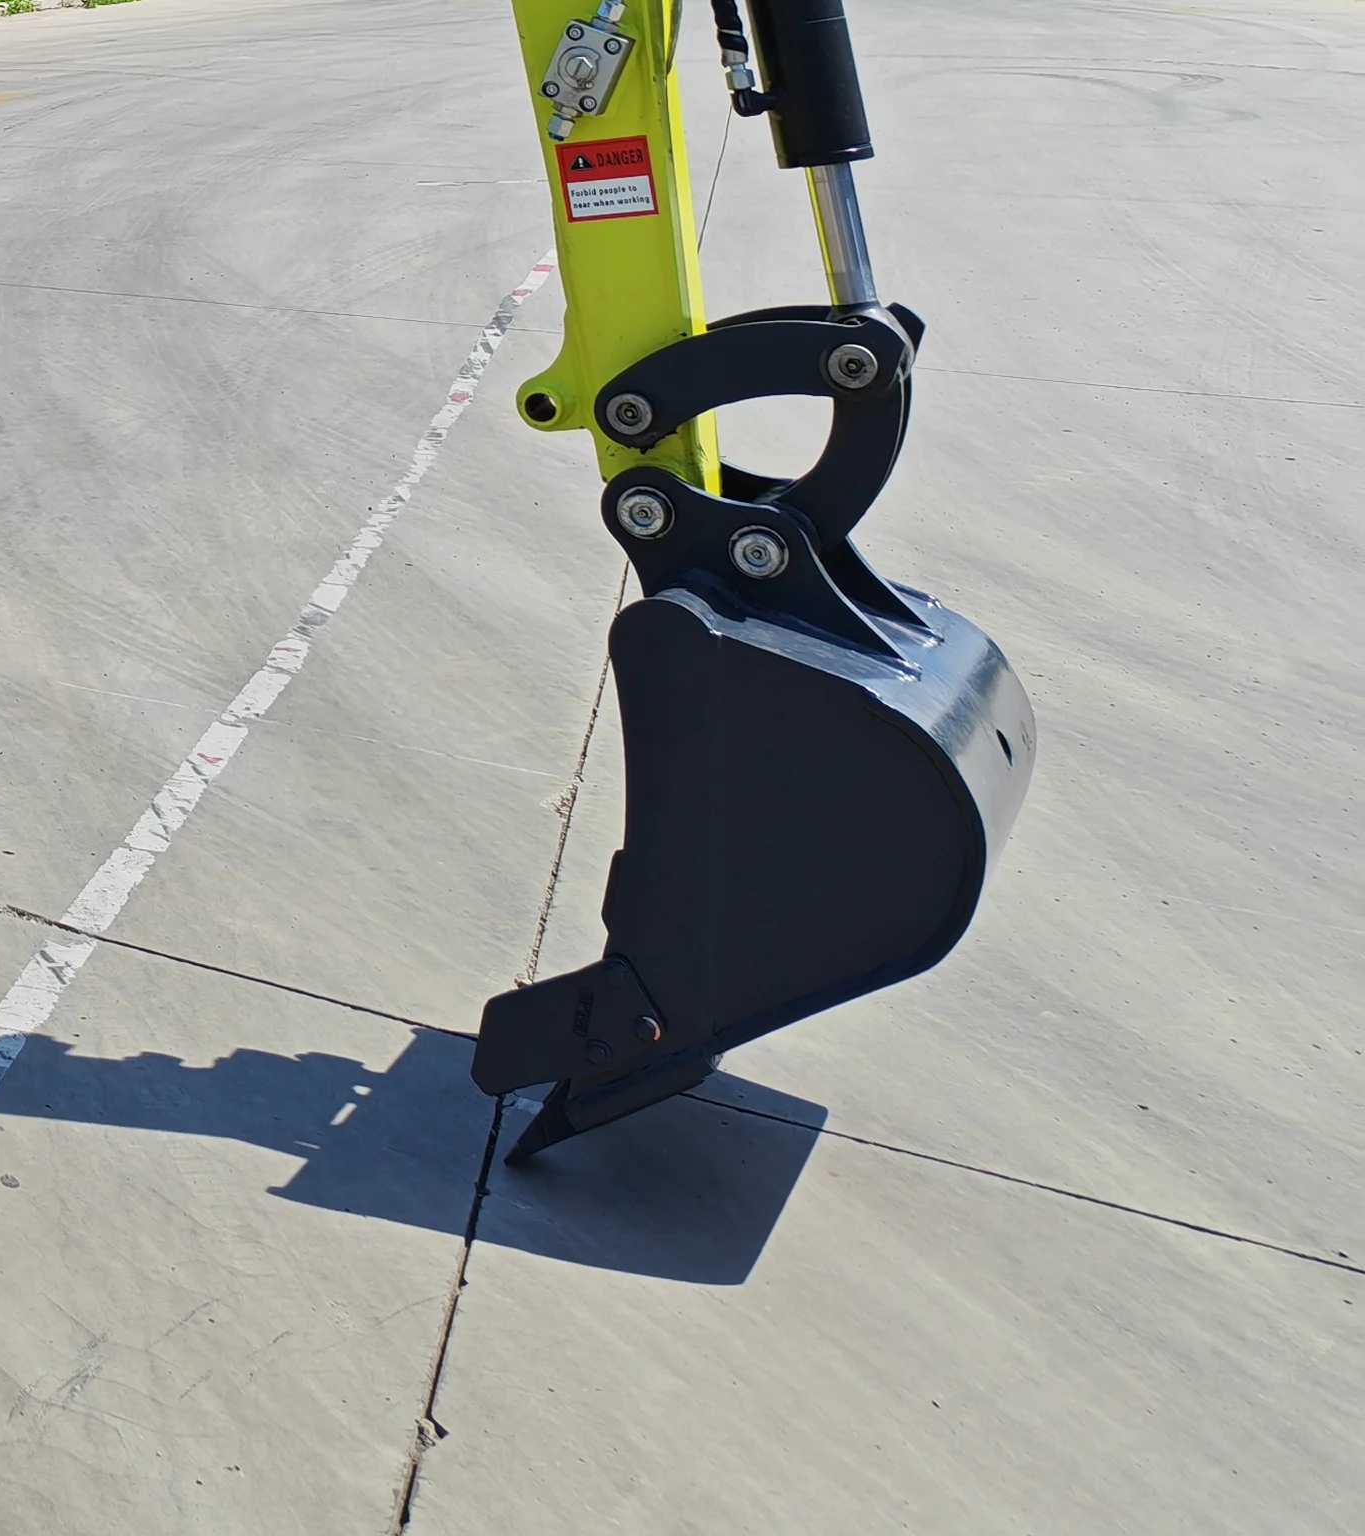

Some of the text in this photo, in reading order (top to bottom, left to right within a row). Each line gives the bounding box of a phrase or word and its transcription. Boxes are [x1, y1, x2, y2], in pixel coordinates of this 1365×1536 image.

[596, 149, 644, 167] DANGER
[570, 188, 597, 197] Forbid
[599, 185, 626, 195] people
[573, 196, 650, 209] near when working
